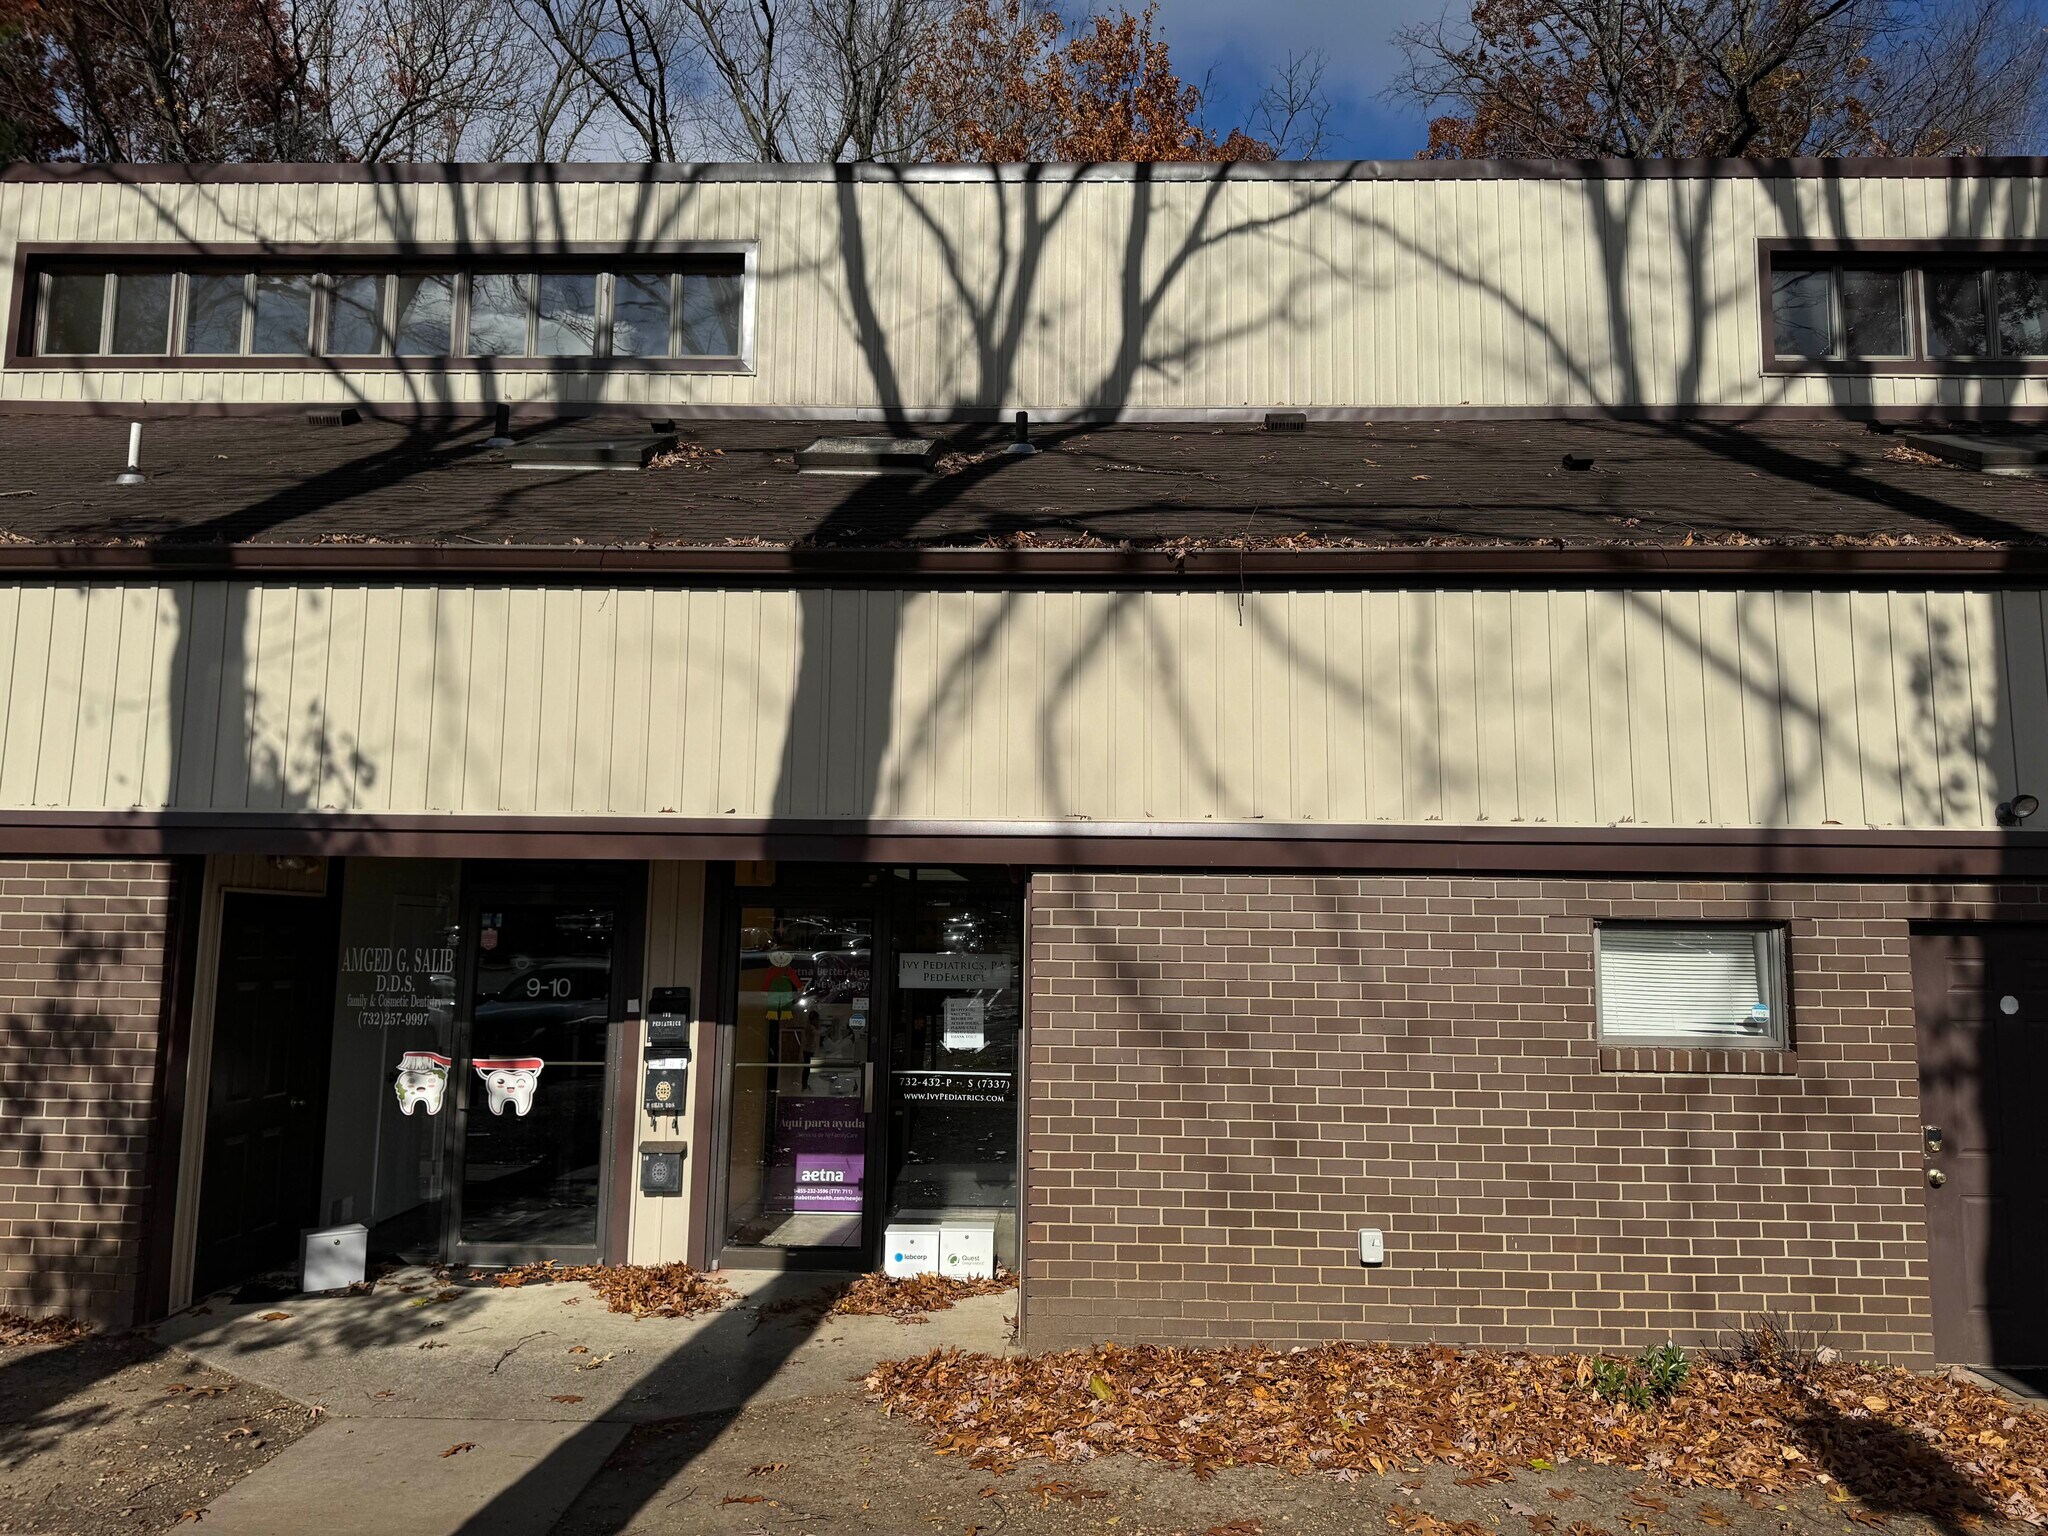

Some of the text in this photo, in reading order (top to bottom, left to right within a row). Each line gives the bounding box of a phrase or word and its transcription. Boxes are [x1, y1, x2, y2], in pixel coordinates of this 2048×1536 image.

[341, 947, 454, 973] AMGED G. SALIB
[375, 975, 415, 992] D.D.S.
[526, 978, 571, 998] 9-10
[369, 994, 376, 1007] &
[378, 994, 409, 1007] Cosmetic
[410, 995, 442, 1009] Dentistry
[358, 1010, 429, 1029] (732)257-9997
[977, 1079, 1010, 1089] (7337)
[804, 1121, 830, 1130] para
[832, 1118, 865, 1131] ayuda
[801, 1168, 844, 1182] aetna
